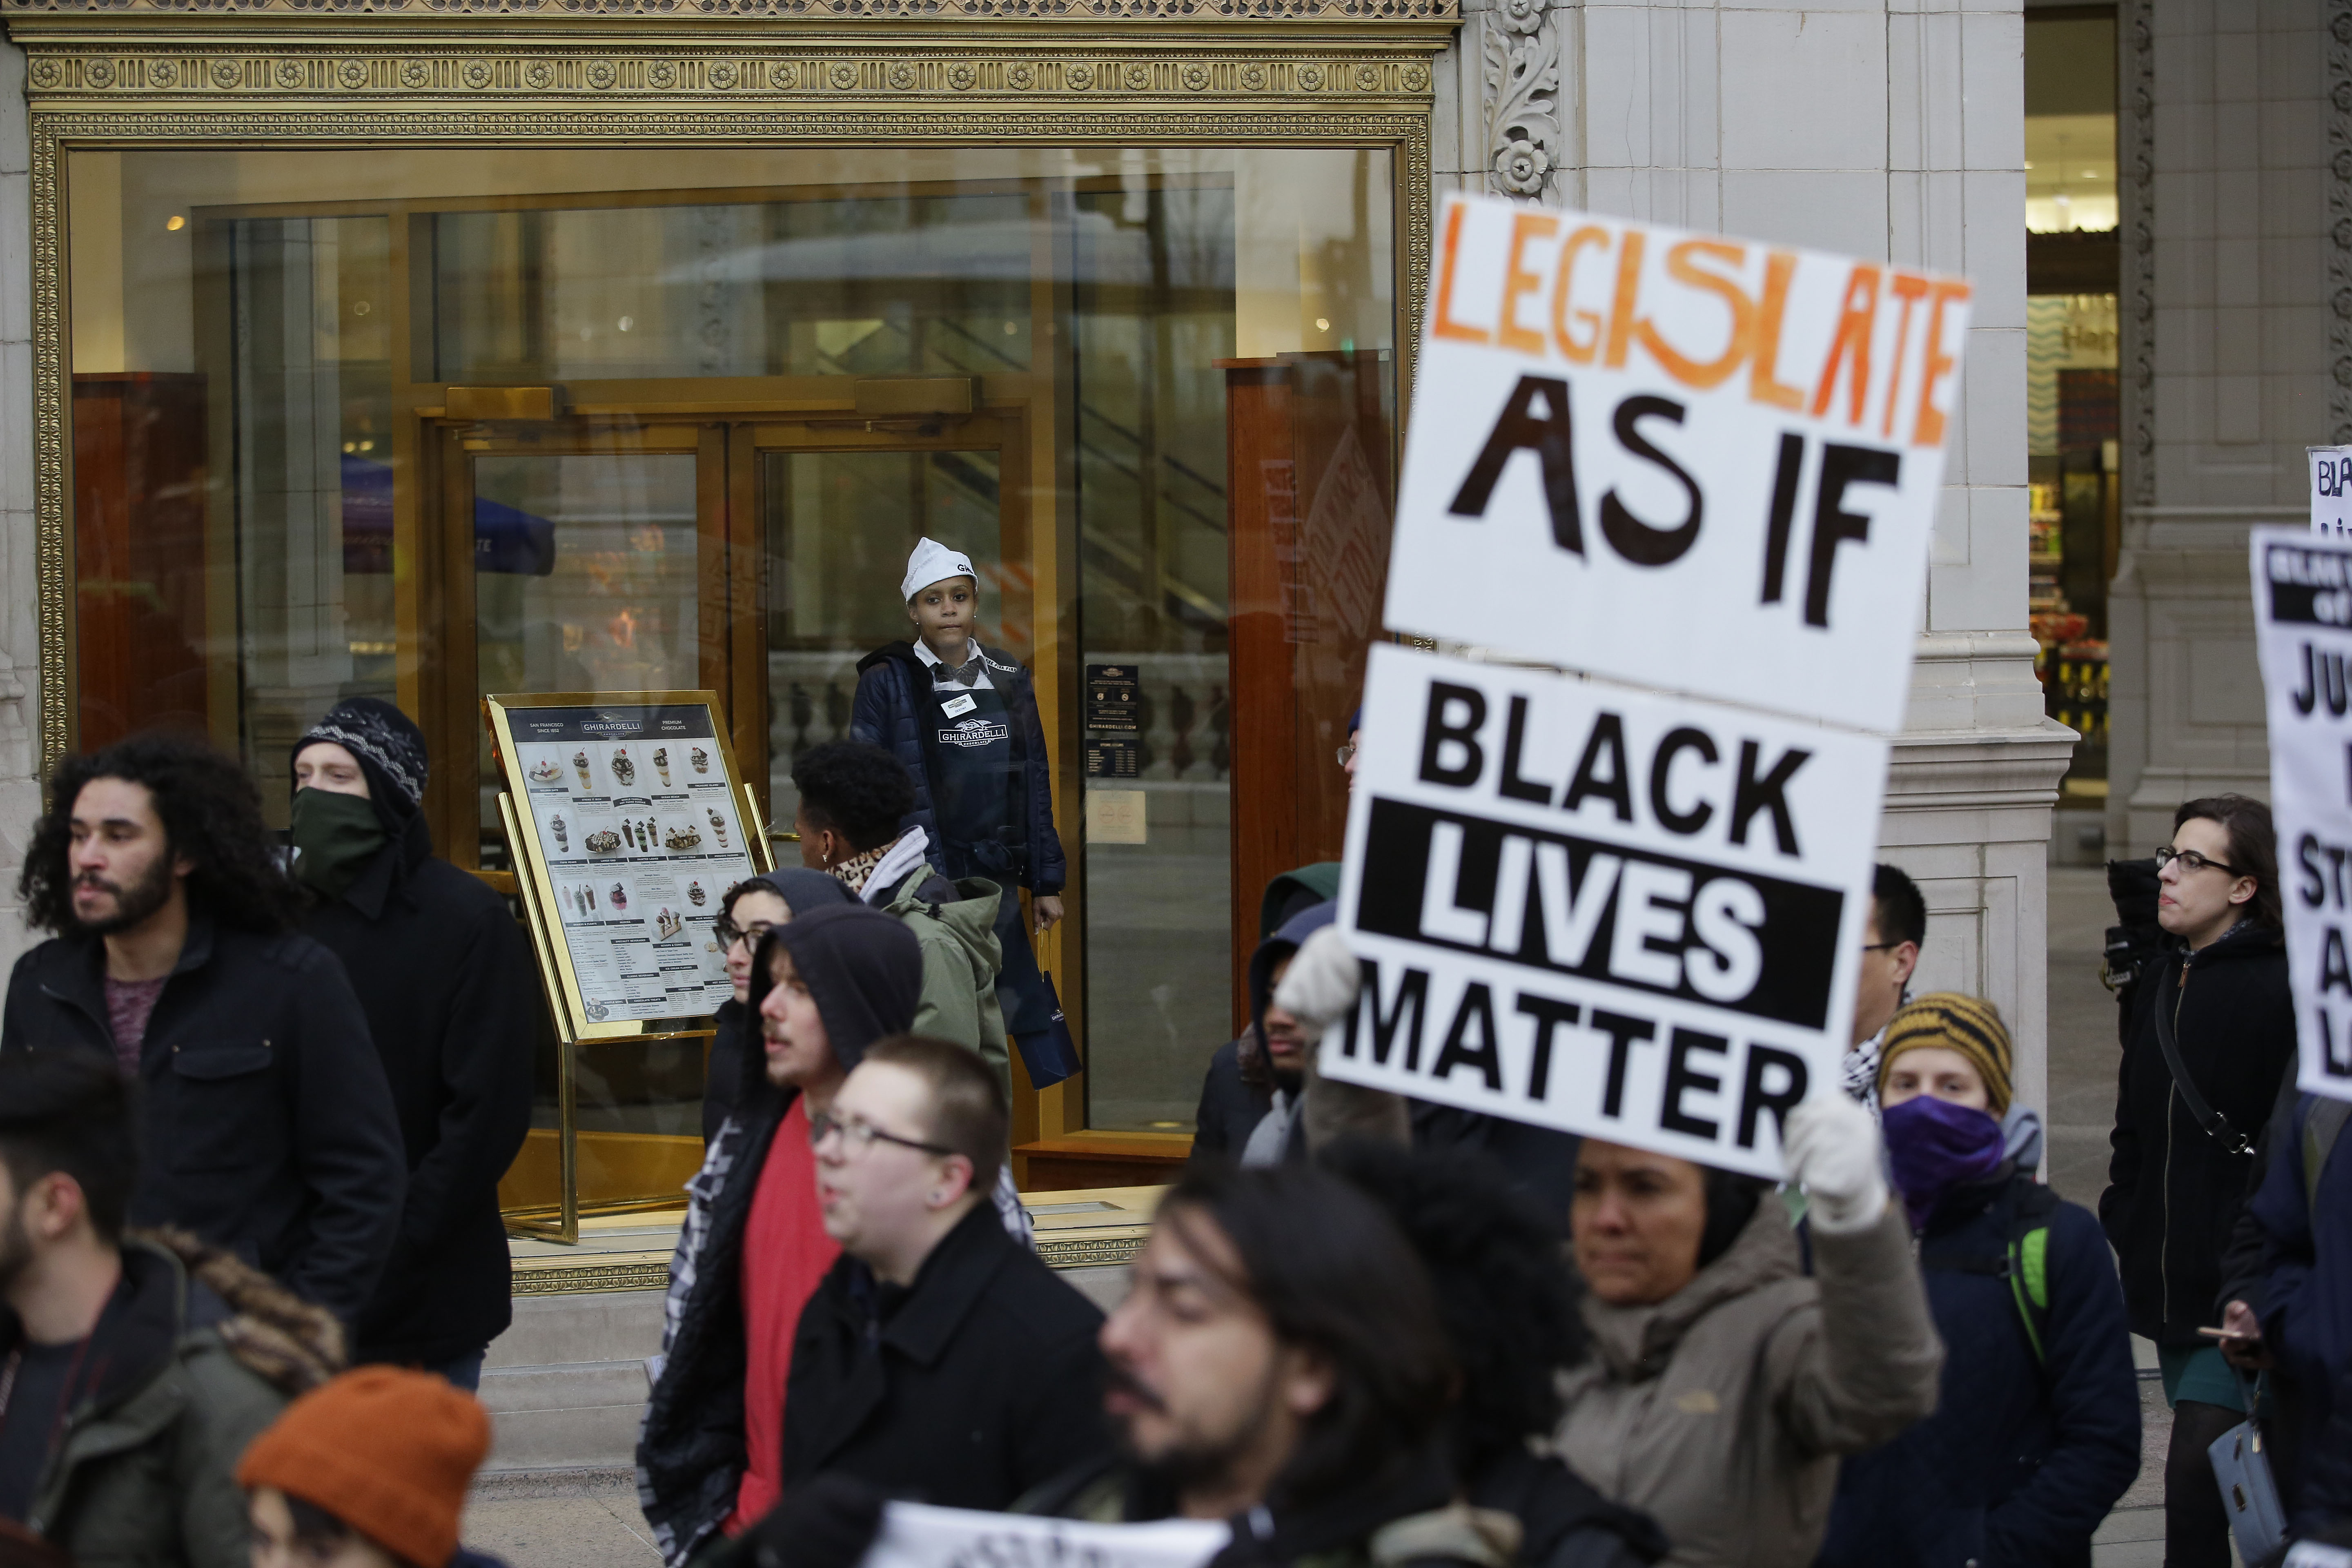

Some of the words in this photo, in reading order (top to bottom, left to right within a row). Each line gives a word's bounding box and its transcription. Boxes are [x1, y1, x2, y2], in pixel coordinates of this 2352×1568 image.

[1432, 201, 1973, 448] LEGISLATE
[1446, 374, 1707, 568] AS
[1758, 430, 1902, 629] IF
[942, 729, 1006, 741] GHIRARDELLI
[1417, 678, 1815, 858] BLACK
[1419, 820, 1767, 1003] LIVES
[1339, 957, 1810, 1152] MATTER
